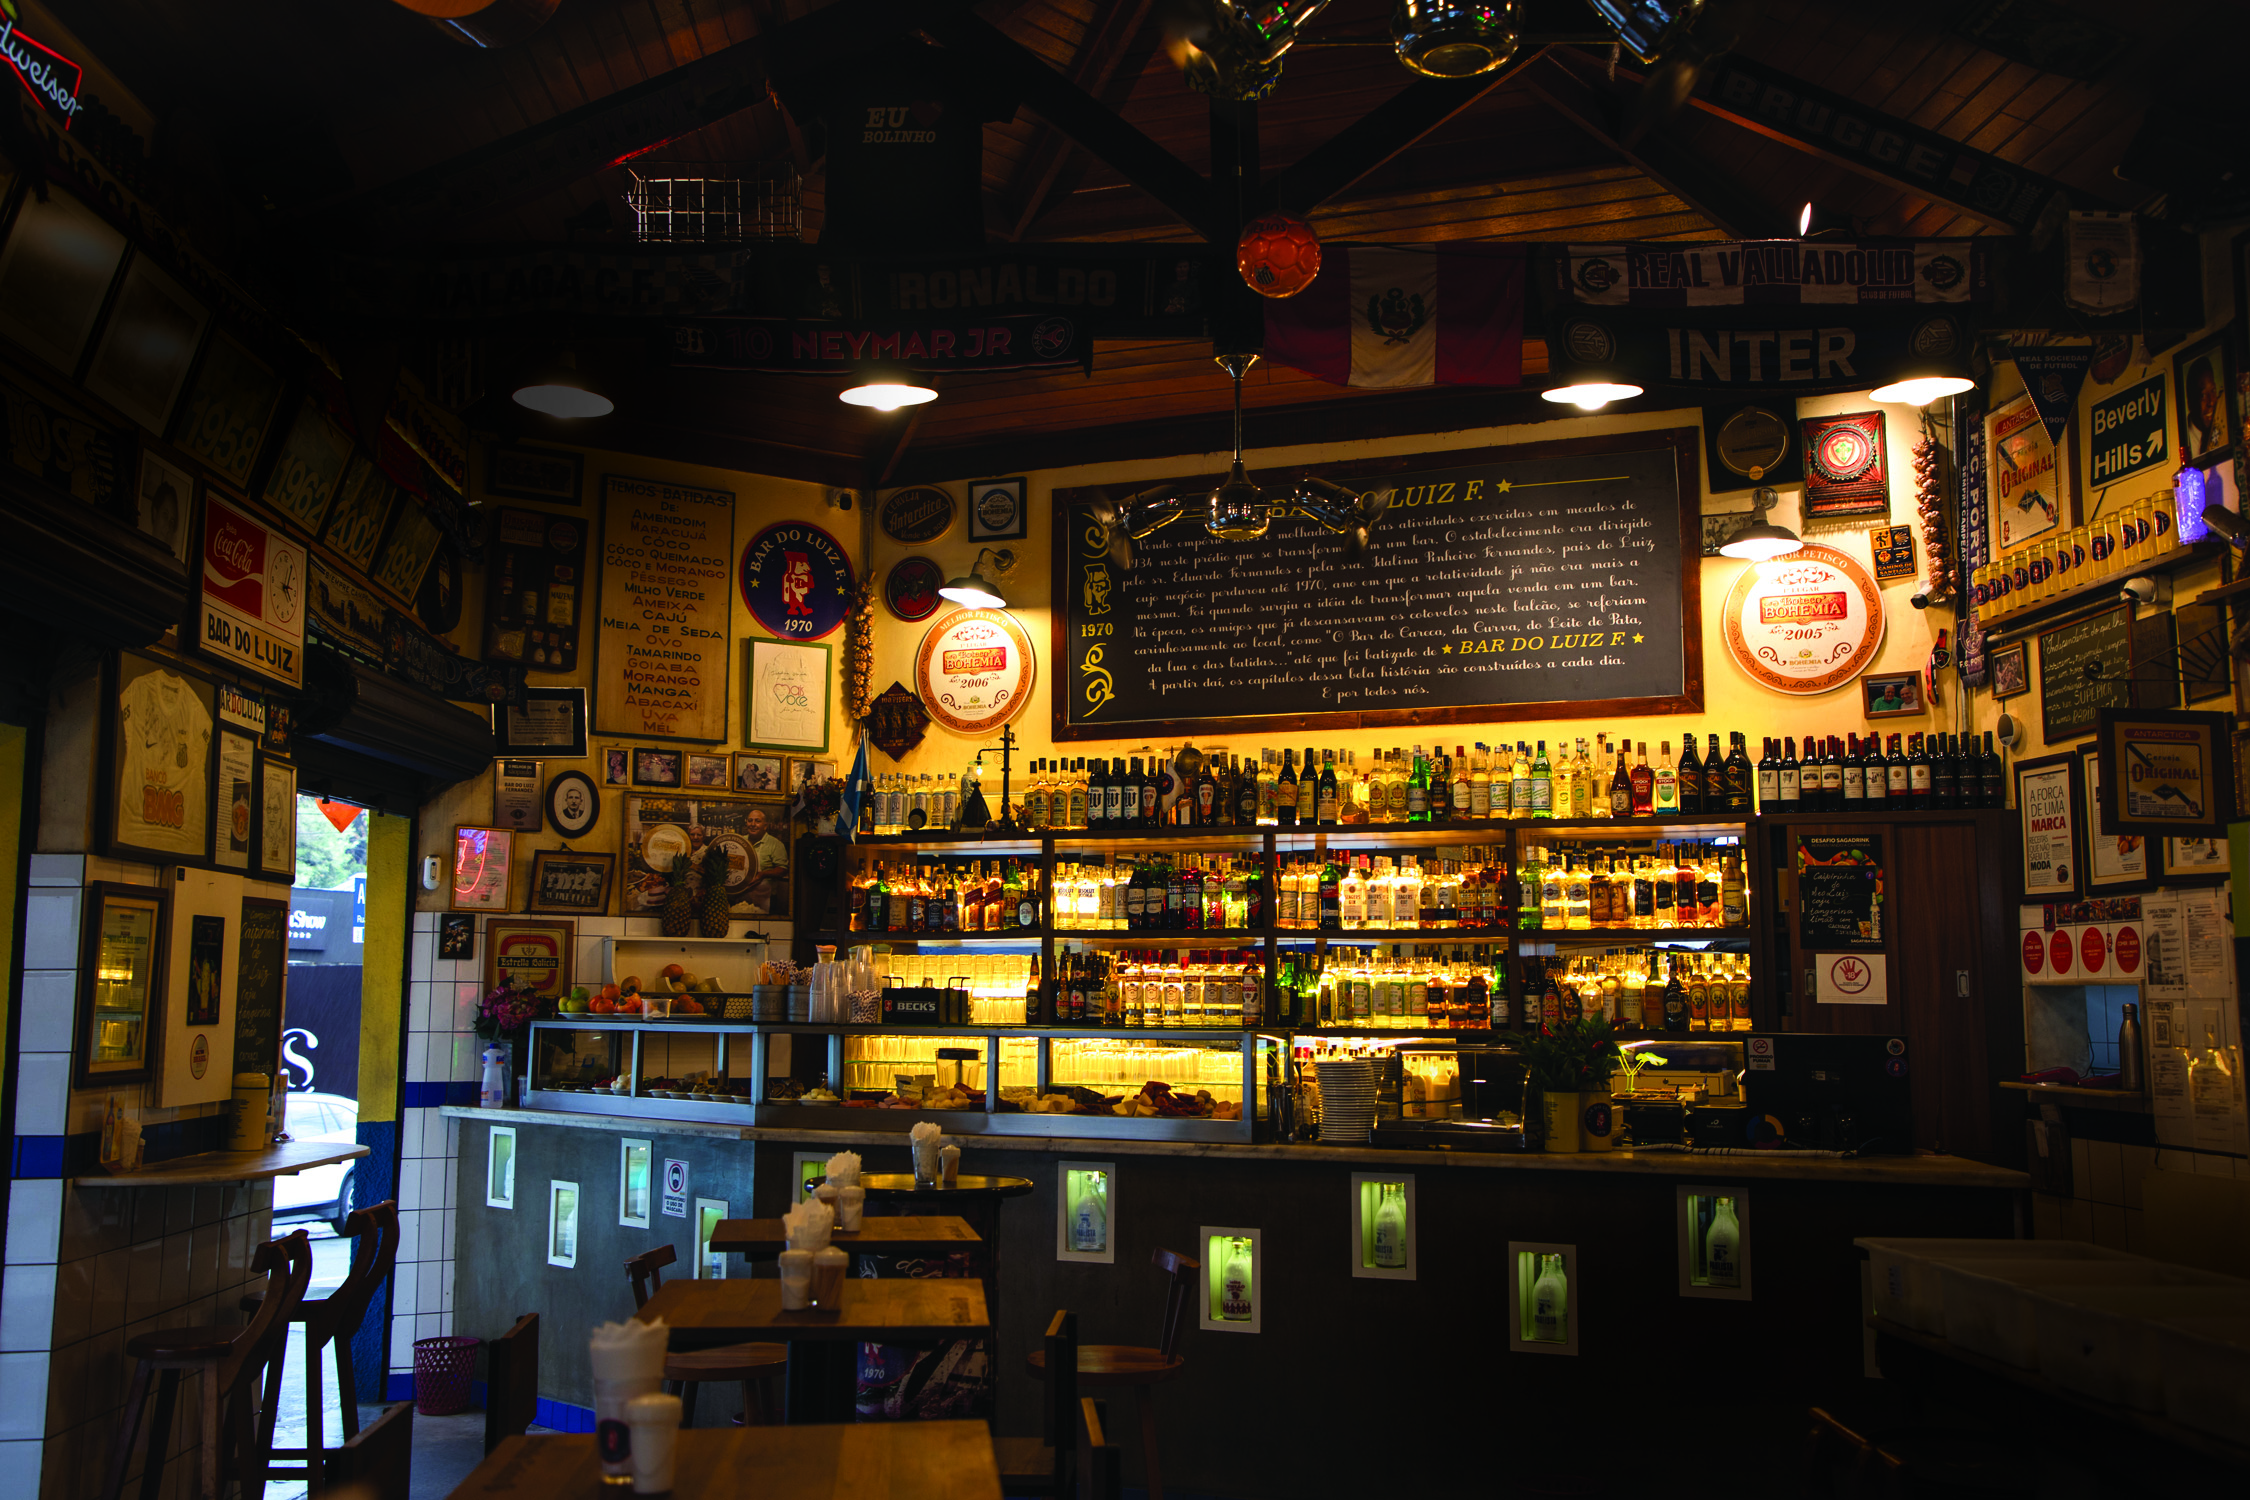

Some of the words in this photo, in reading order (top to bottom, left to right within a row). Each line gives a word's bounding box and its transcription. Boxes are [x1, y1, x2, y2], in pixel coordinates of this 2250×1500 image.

[865, 107, 909, 128] EU
[862, 130, 936, 143] BOLINHO
[1628, 250, 1711, 288] REAL
[1718, 249, 1915, 287] VALLADOLID
[900, 263, 1117, 311] RONALDO
[725, 327, 773, 359] 10
[792, 329, 956, 360] NEYMAR
[964, 327, 1012, 357] JR
[1666, 327, 1857, 381] INTER
[2094, 388, 2161, 436] Beverly
[188, 398, 261, 474] 1958
[2094, 443, 2142, 479] Hills
[2001, 454, 2054, 498] ORIGINAL
[886, 492, 919, 514] CERVEJA
[1387, 483, 1456, 509] LUIZ
[1464, 480, 1484, 502] F.
[887, 497, 943, 532] Antarctica
[325, 500, 378, 561] 2002
[750, 540, 774, 573] BAR
[775, 530, 801, 544] DO
[806, 533, 841, 565] LUIZ
[835, 569, 846, 581] F.
[1123, 576, 1145, 592] pelo
[1151, 577, 1166, 585] sr.
[1173, 572, 1223, 582] Eduardo
[1228, 567, 1291, 578] Fernandes
[1309, 561, 1334, 578] pela
[1371, 556, 1419, 568] Idalina
[1425, 552, 1477, 563] Pinheiro
[1482, 545, 1555, 559] Fernandes,
[1563, 540, 1591, 558] pais
[1597, 540, 1613, 549] do
[1619, 536, 1655, 552] Luiz
[1803, 549, 1848, 569] PETISCO
[381, 541, 423, 598] 1994
[939, 611, 973, 632] MELHOR
[974, 610, 1009, 627] PETISCO
[1764, 604, 1842, 619] BOHEMIA
[784, 619, 812, 632] 1970
[1082, 622, 1113, 637] 1970
[1784, 628, 1823, 641] 2005
[208, 613, 230, 646] BAR
[235, 626, 251, 654] DO
[254, 636, 292, 673] LUIZ
[1147, 664, 1162, 673] da
[1168, 661, 1187, 671] lua
[1204, 661, 1225, 670] das
[1318, 654, 1338, 668] que
[1344, 650, 1359, 667] foi
[1365, 648, 1417, 664] batizado
[1423, 646, 1437, 656] de
[1459, 639, 1507, 656] BAR
[1510, 636, 1544, 651] DO
[1550, 632, 1604, 649] LUIZ
[1609, 632, 1626, 646] F.
[945, 656, 1003, 669] BOHEMIA
[960, 678, 989, 688] 2006
[1162, 679, 1199, 695] partir
[1203, 678, 1224, 688] daí,
[1248, 674, 1304, 691] capítulos
[1309, 671, 1343, 682] dessa
[1348, 667, 1375, 679] bela
[1381, 666, 1431, 677] história
[1436, 663, 1458, 674] são
[1463, 661, 1542, 674] construídos
[1547, 660, 1557, 668] a
[1562, 657, 1594, 668] cada
[1599, 655, 1625, 666] dia.
[1322, 687, 1332, 699] E
[1337, 689, 1359, 704] por
[1365, 686, 1397, 697] todos
[1403, 685, 1429, 695] nós.
[2133, 731, 2191, 739] ANTARCTICA
[2146, 753, 2180, 762] Cerveja
[2131, 763, 2199, 782] ORIGINAL
[2030, 789, 2036, 800] A
[2037, 786, 2064, 803] FORÇA
[143, 785, 184, 829] BMG
[2031, 804, 2042, 817] DE
[2044, 800, 2065, 815] UMA
[2031, 816, 2066, 832] MARCA
[2030, 861, 2051, 871] MODA
[864, 1368, 884, 1379] 1970
